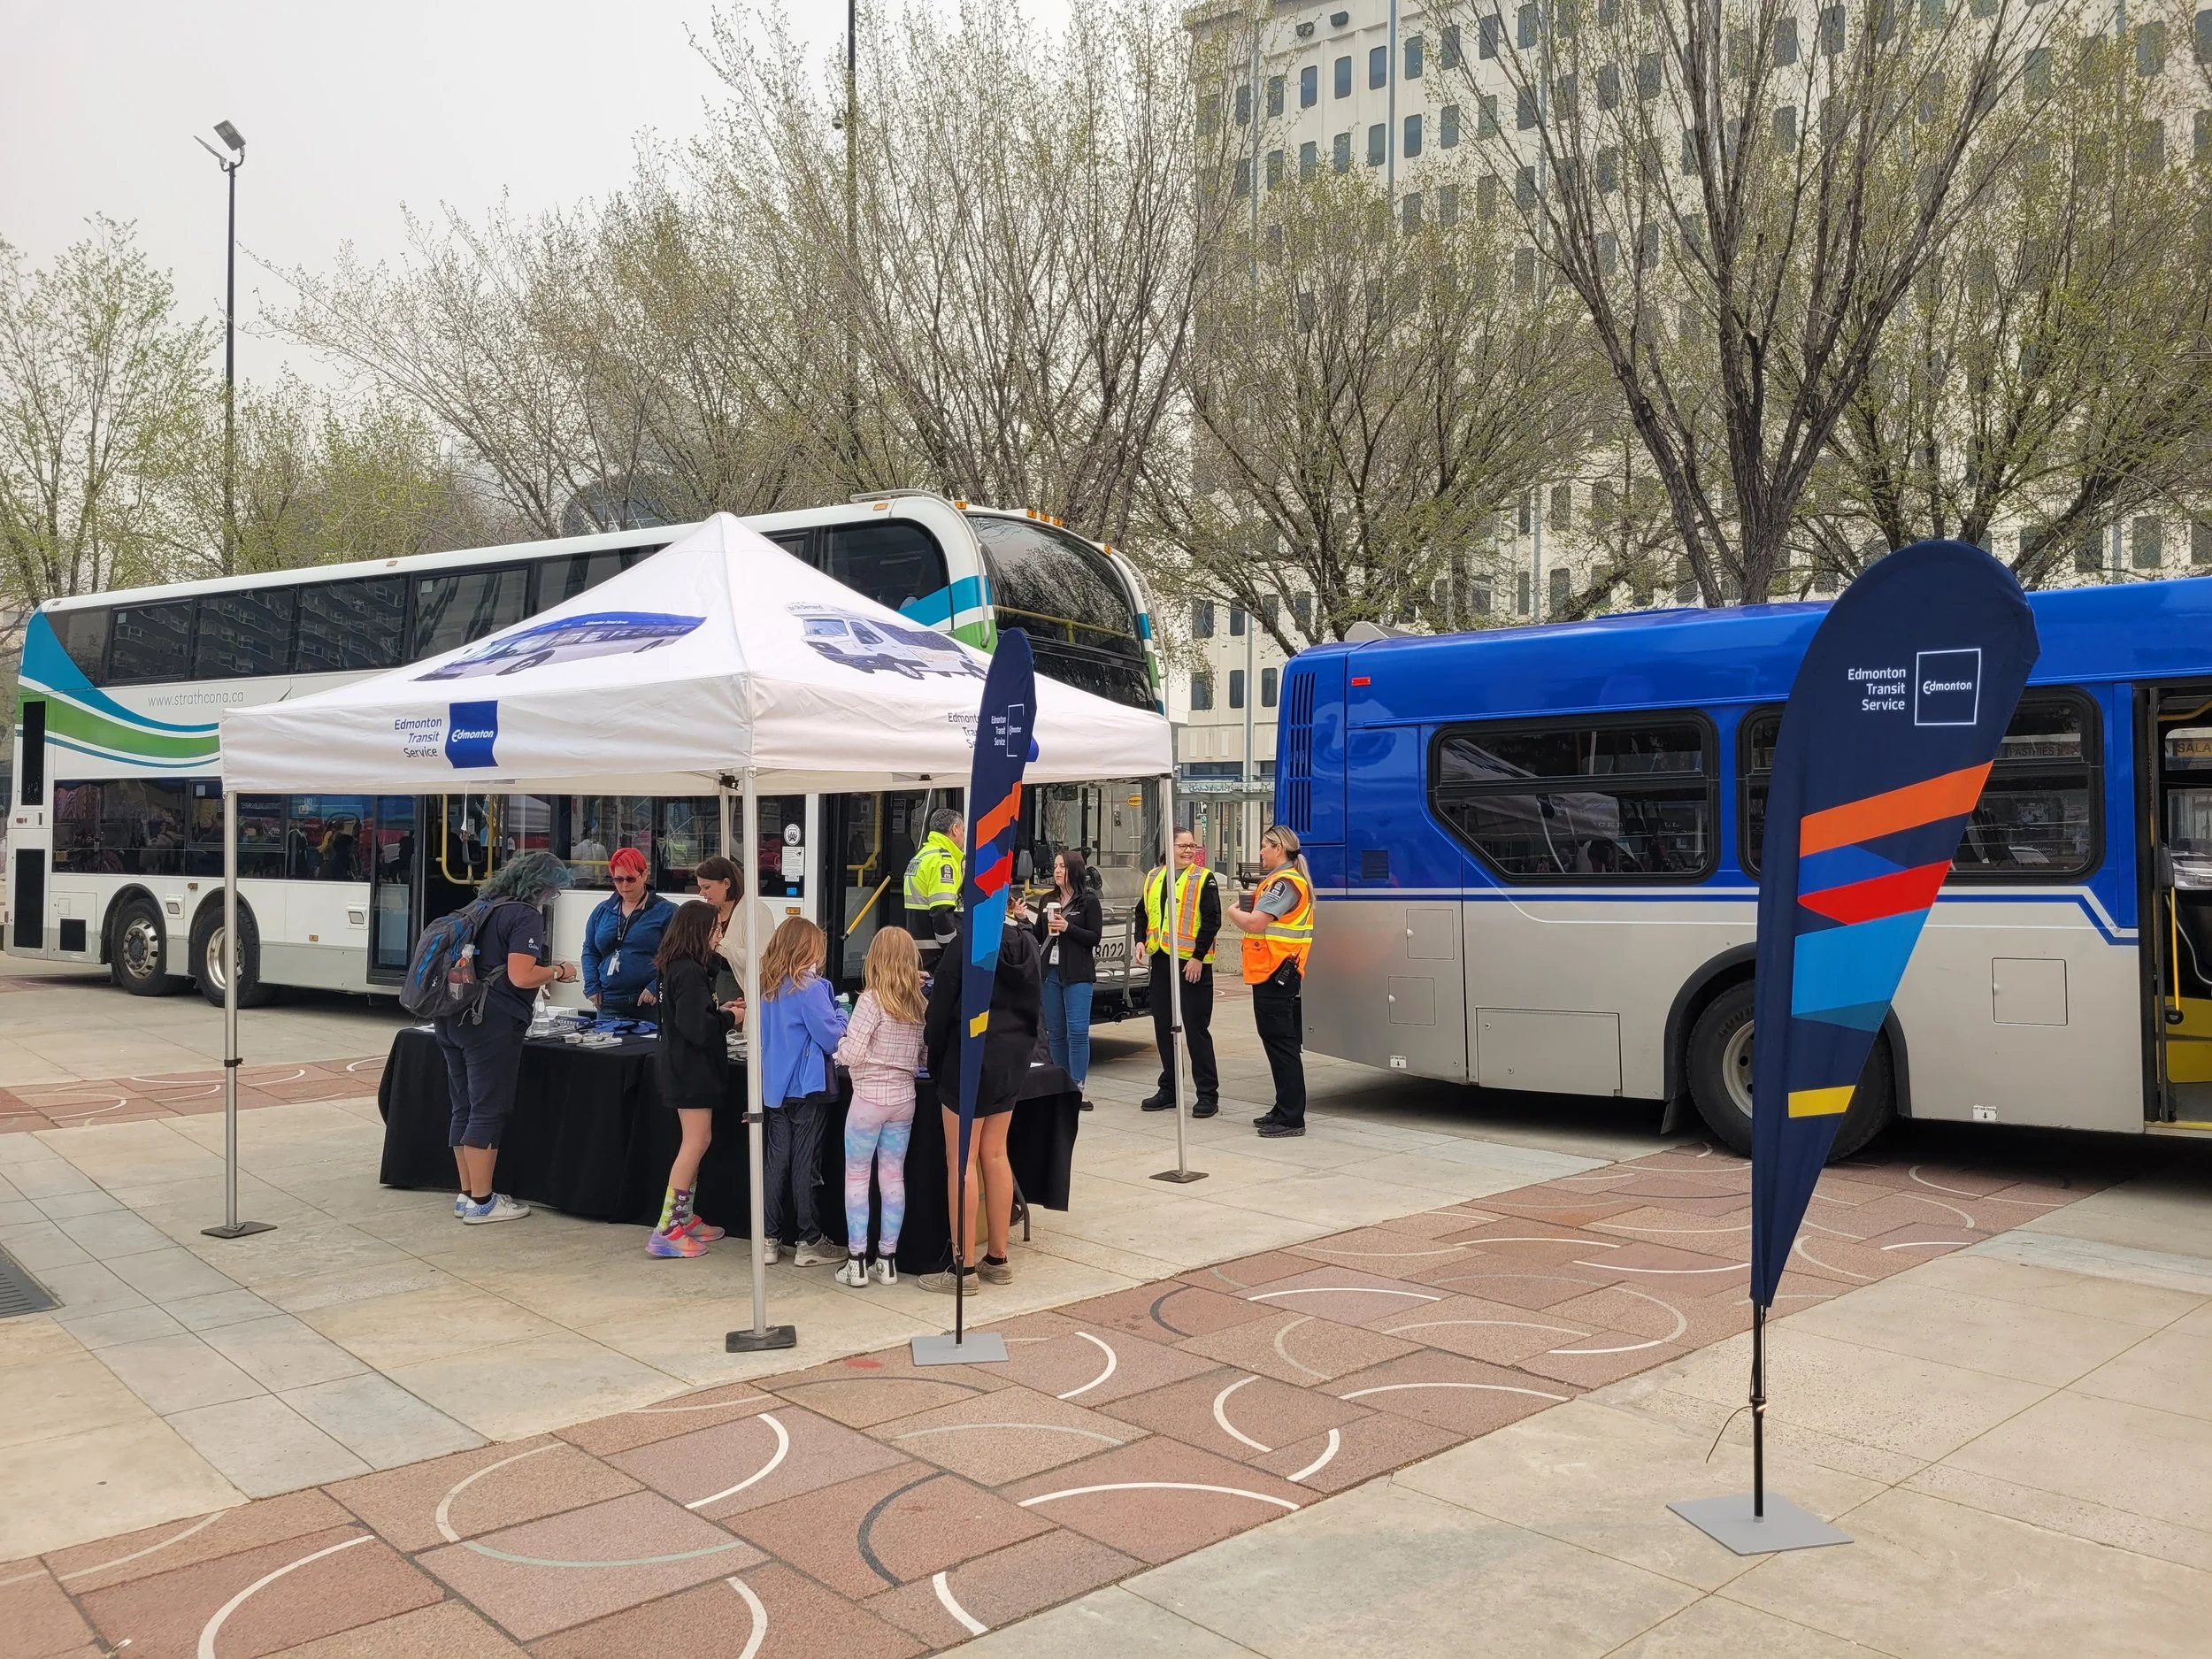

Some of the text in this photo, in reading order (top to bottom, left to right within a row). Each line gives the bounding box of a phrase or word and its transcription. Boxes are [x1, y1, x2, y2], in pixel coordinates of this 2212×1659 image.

[1847, 667, 1906, 680] Edmonton
[1866, 682, 1906, 695] Transit
[1923, 680, 1972, 695] Edmonton
[148, 689, 243, 707] www.strathcona.ca
[1862, 698, 1906, 710] Service
[395, 718, 442, 730] Edmonton
[995, 726, 1006, 734] Transit
[407, 731, 440, 743] Transit
[451, 729, 494, 742] Edmonton
[962, 726, 978, 737] Tra
[994, 737, 1006, 746] Service
[403, 746, 438, 758] Service
[1094, 942, 1124, 957] 8022
